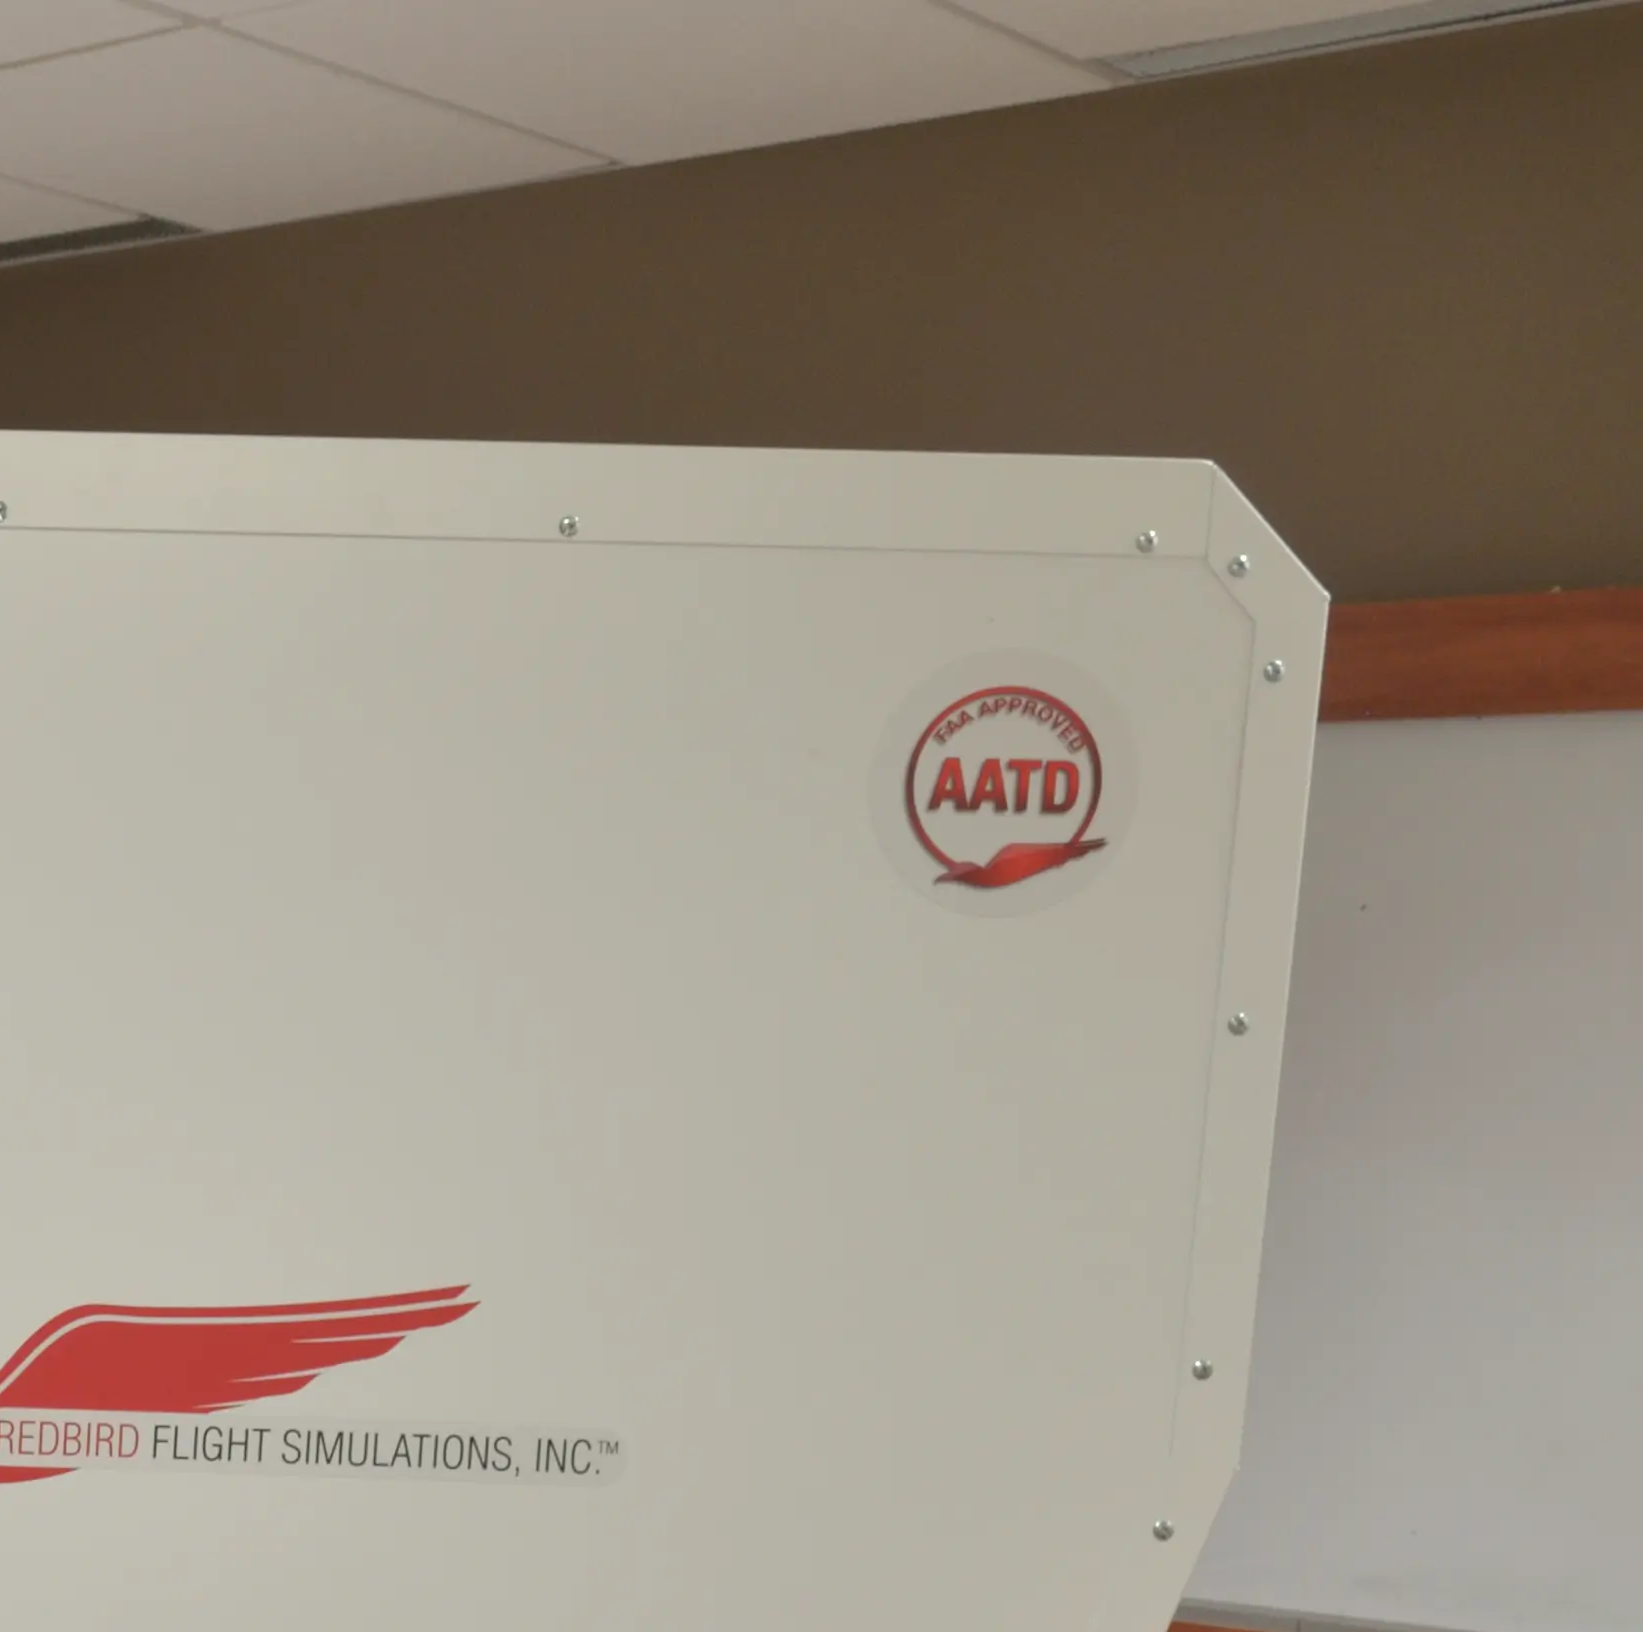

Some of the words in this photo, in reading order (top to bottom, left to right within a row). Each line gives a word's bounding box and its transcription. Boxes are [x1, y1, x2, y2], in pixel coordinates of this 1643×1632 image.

[933, 710, 975, 745] FAA
[978, 696, 1086, 754] APPROVED
[926, 757, 1080, 814] AATD
[153, 1424, 271, 1463] FLIGHT
[281, 1428, 520, 1477] SIMULATIONS,
